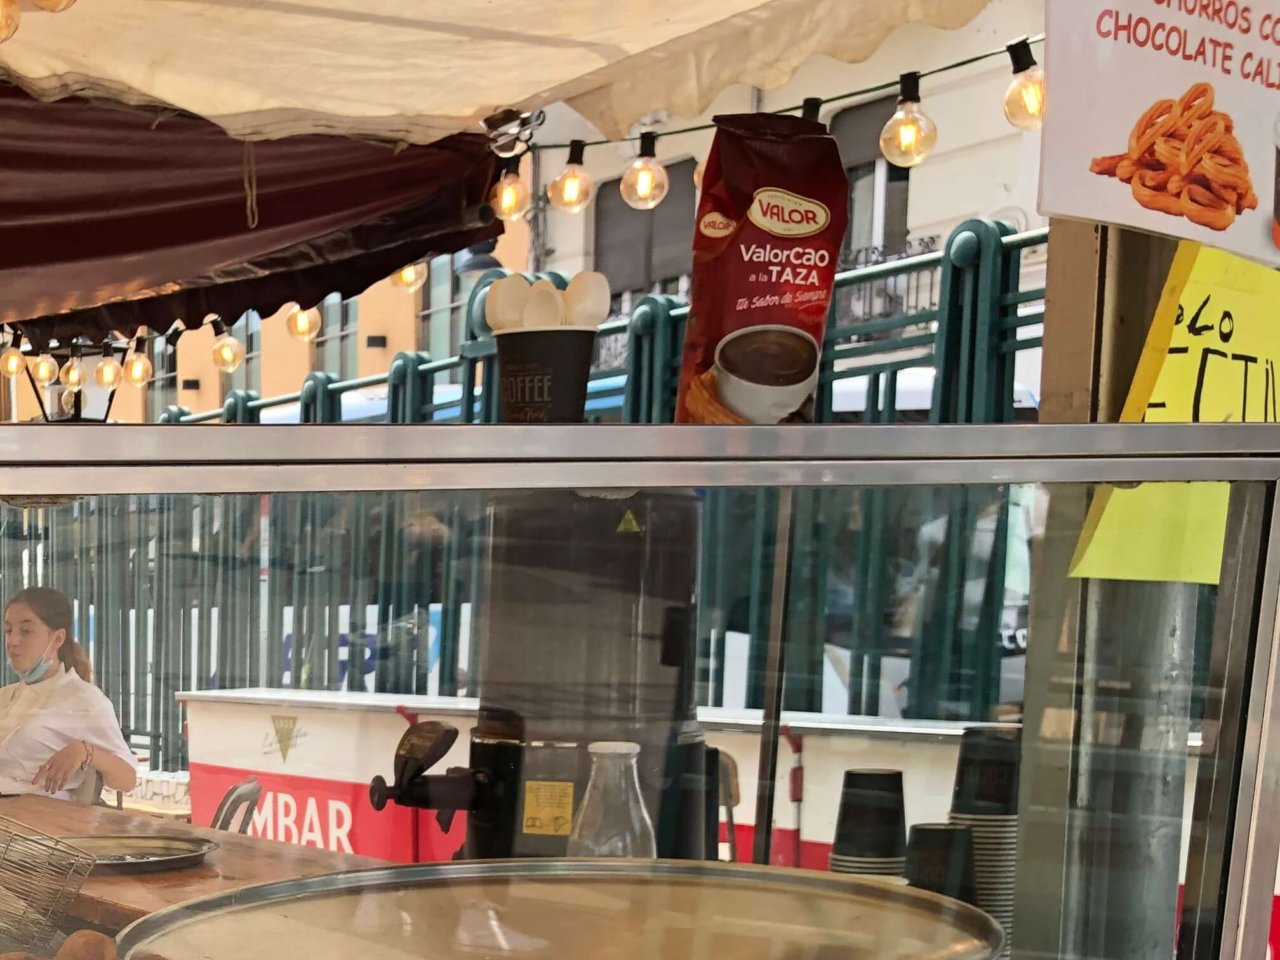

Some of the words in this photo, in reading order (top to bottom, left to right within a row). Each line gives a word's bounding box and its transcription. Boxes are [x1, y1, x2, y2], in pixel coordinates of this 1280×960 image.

[1154, 0, 1252, 34] URROS
[1096, 10, 1234, 75] CHOCOLATE
[1240, 52, 1280, 90] CAL
[703, 220, 731, 231] VALOR
[757, 199, 819, 226] VALOR
[748, 274, 757, 283] a
[758, 272, 769, 283] la
[768, 266, 820, 287] TAZA
